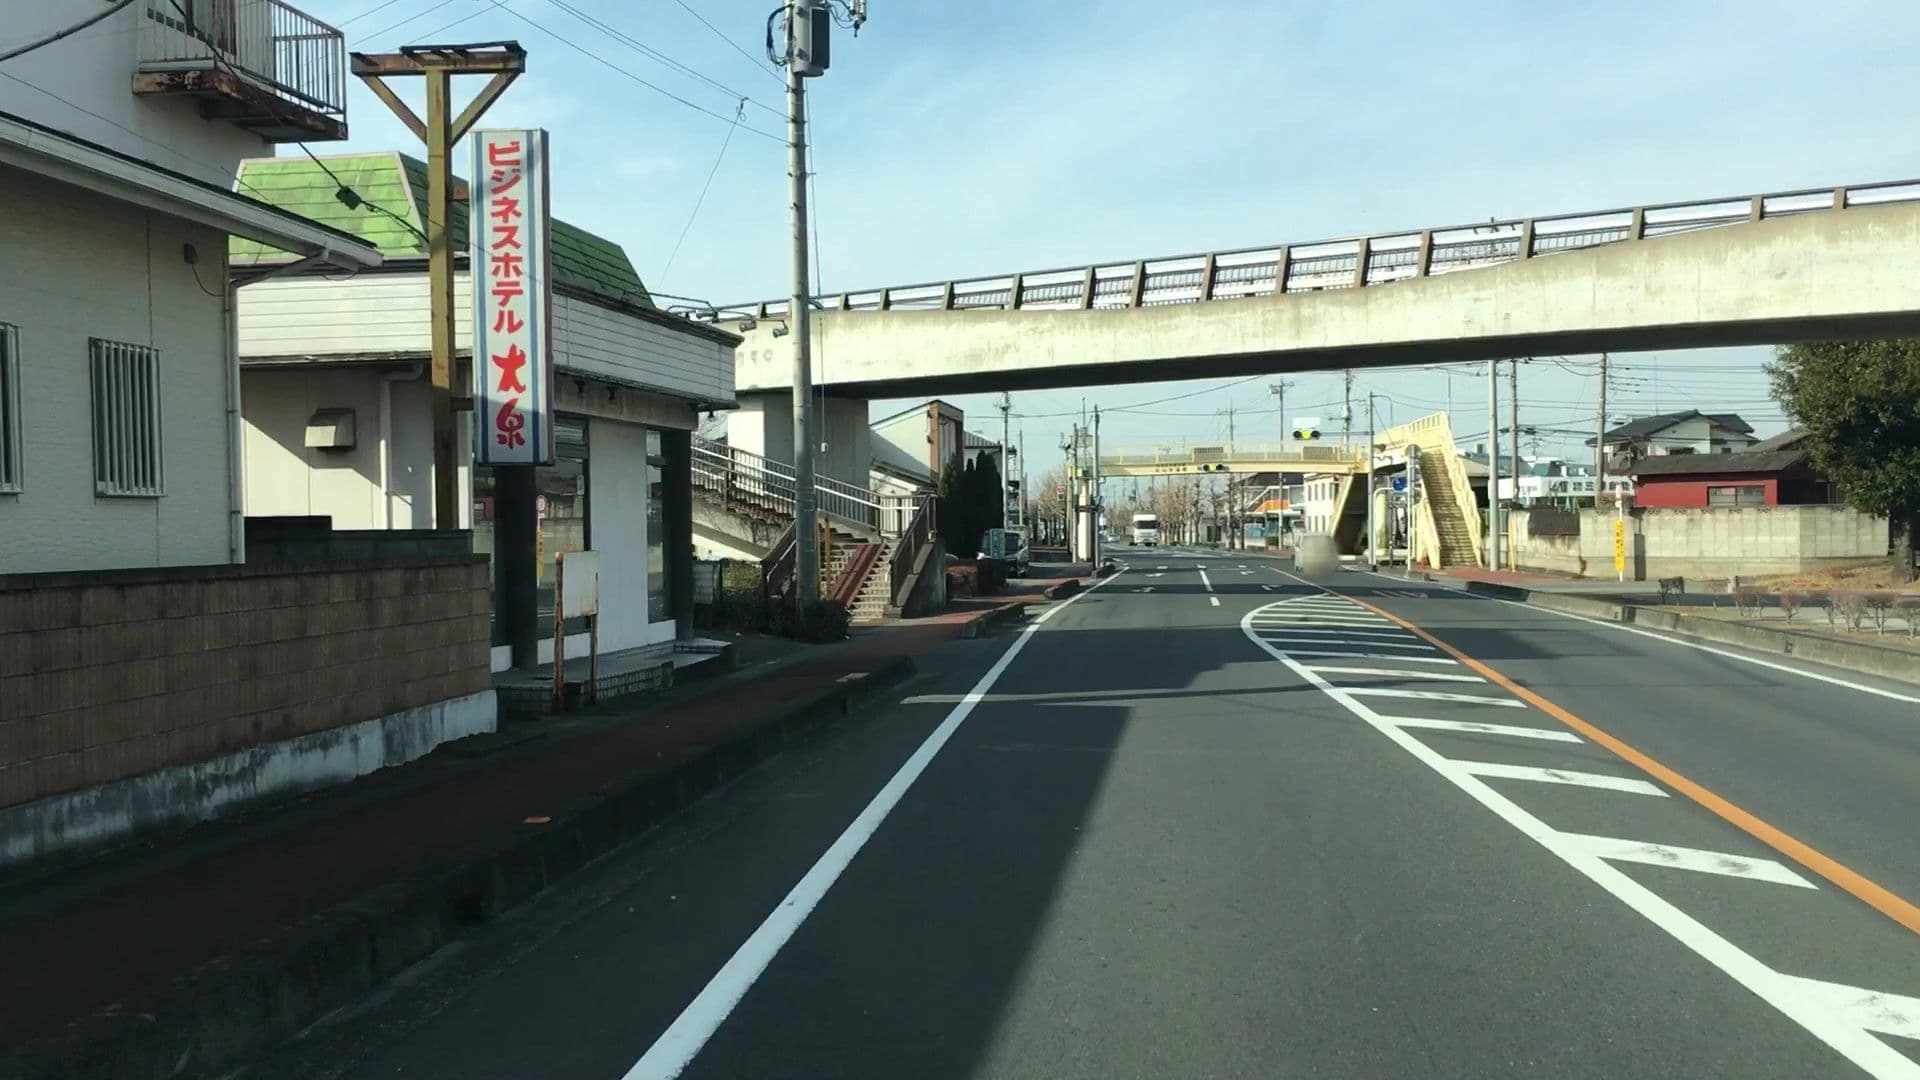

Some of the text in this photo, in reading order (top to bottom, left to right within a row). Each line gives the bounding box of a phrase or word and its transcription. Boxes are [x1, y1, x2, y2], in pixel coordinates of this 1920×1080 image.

[488, 141, 524, 334] ビジネスホテル
